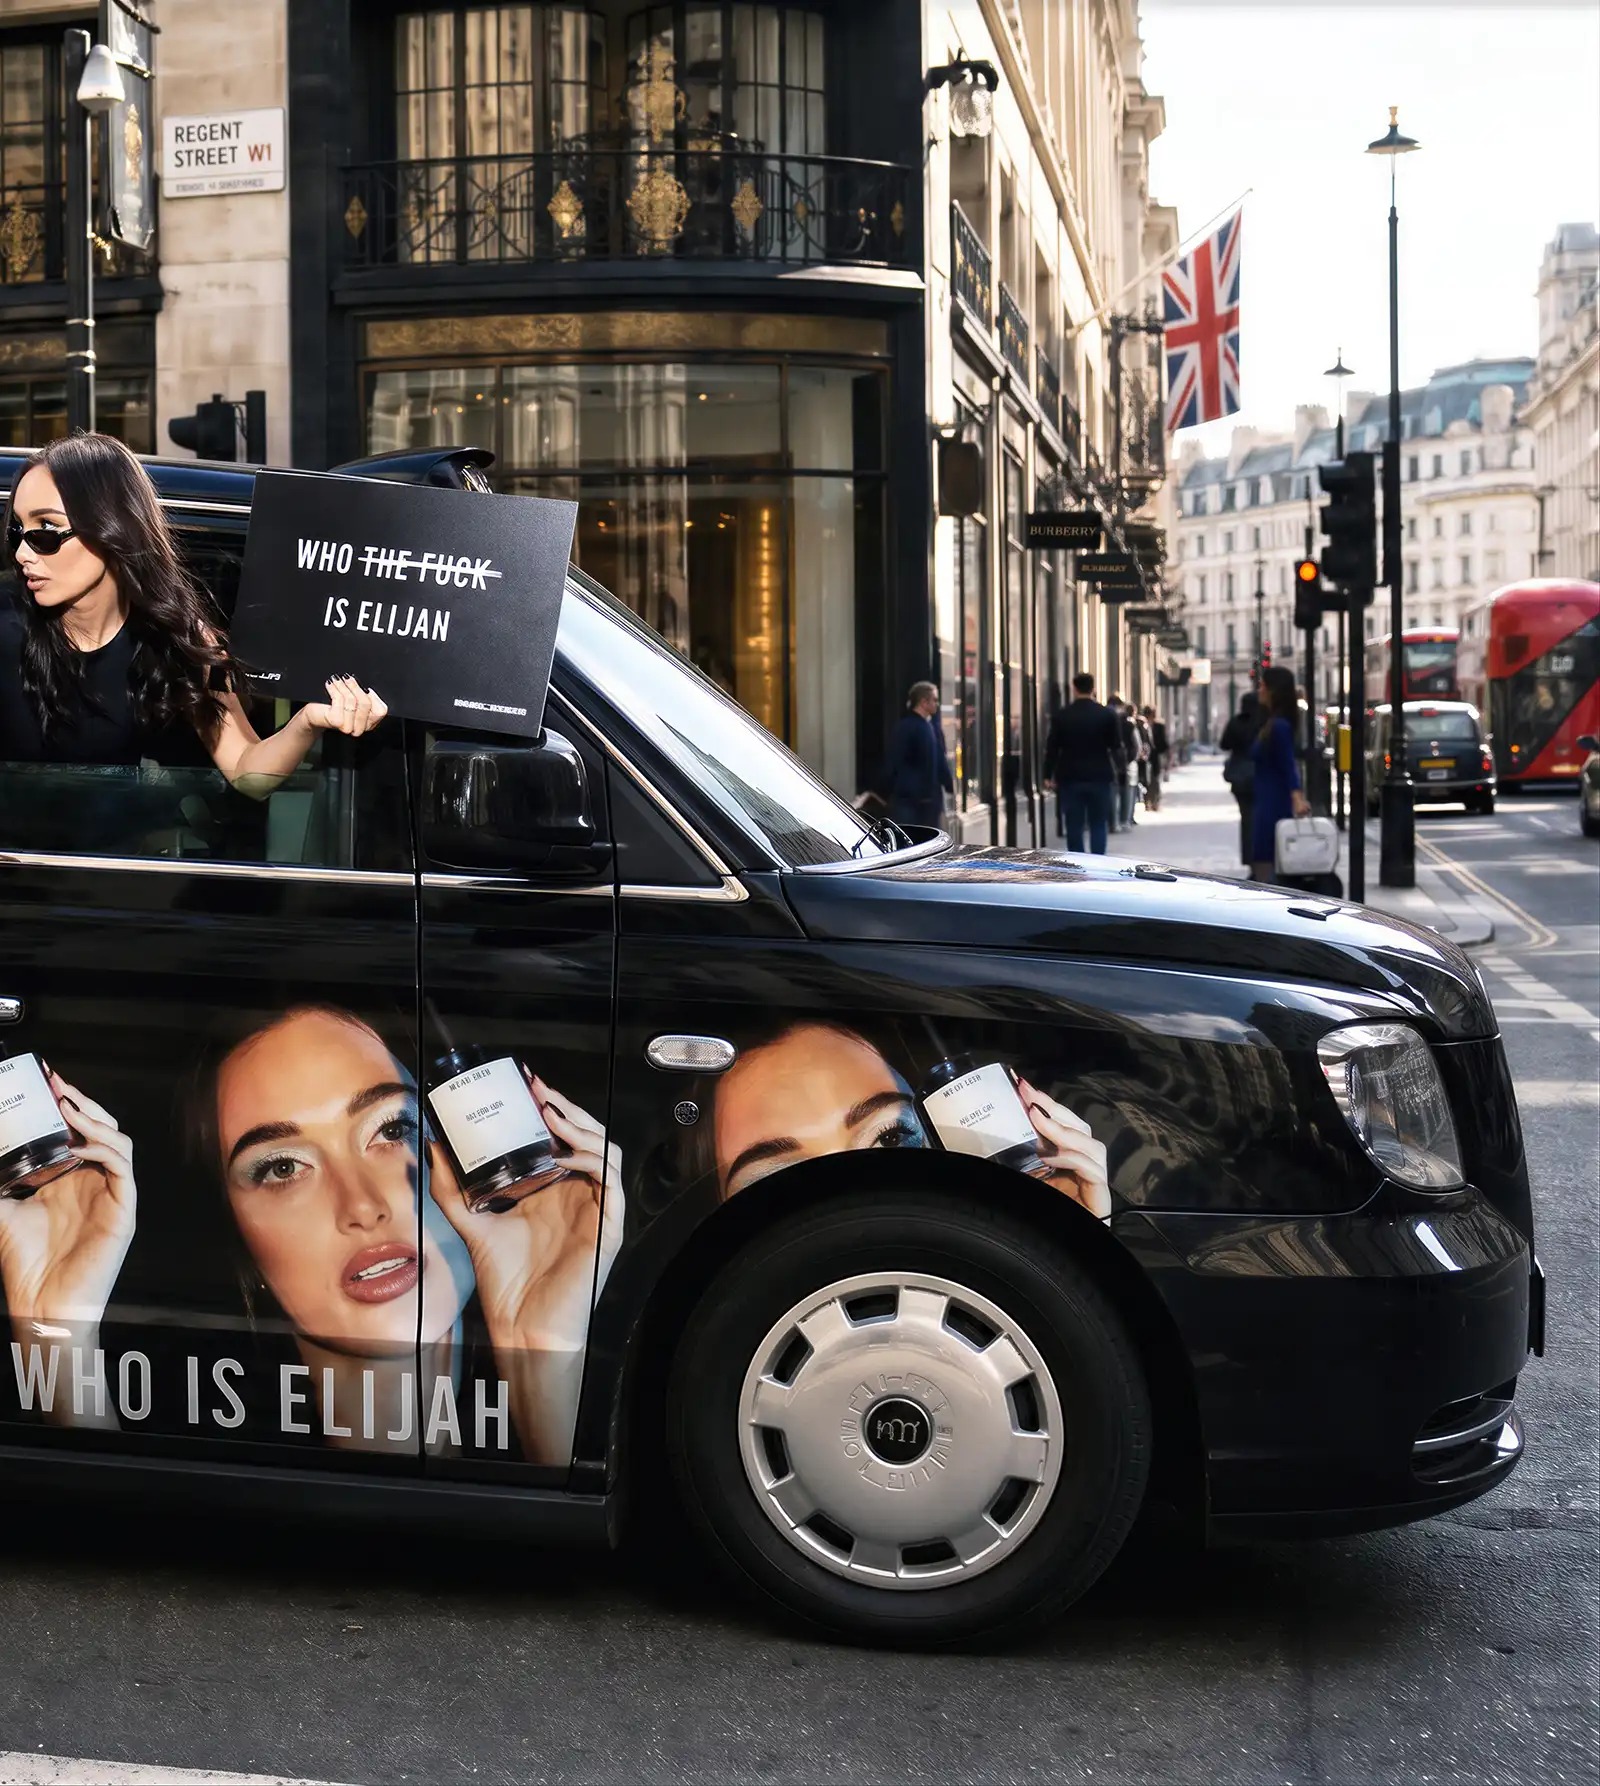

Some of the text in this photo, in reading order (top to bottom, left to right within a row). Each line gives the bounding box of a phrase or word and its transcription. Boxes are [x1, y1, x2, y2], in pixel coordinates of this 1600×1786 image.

[174, 121, 243, 144] REGENT
[174, 143, 272, 168] STREET W1
[1029, 526, 1096, 537] BURBERRY
[298, 538, 493, 590] WHO THE FUCK
[324, 596, 450, 642] IS ELIJAN
[10, 1342, 510, 1451] WHO IS ELIJAH
